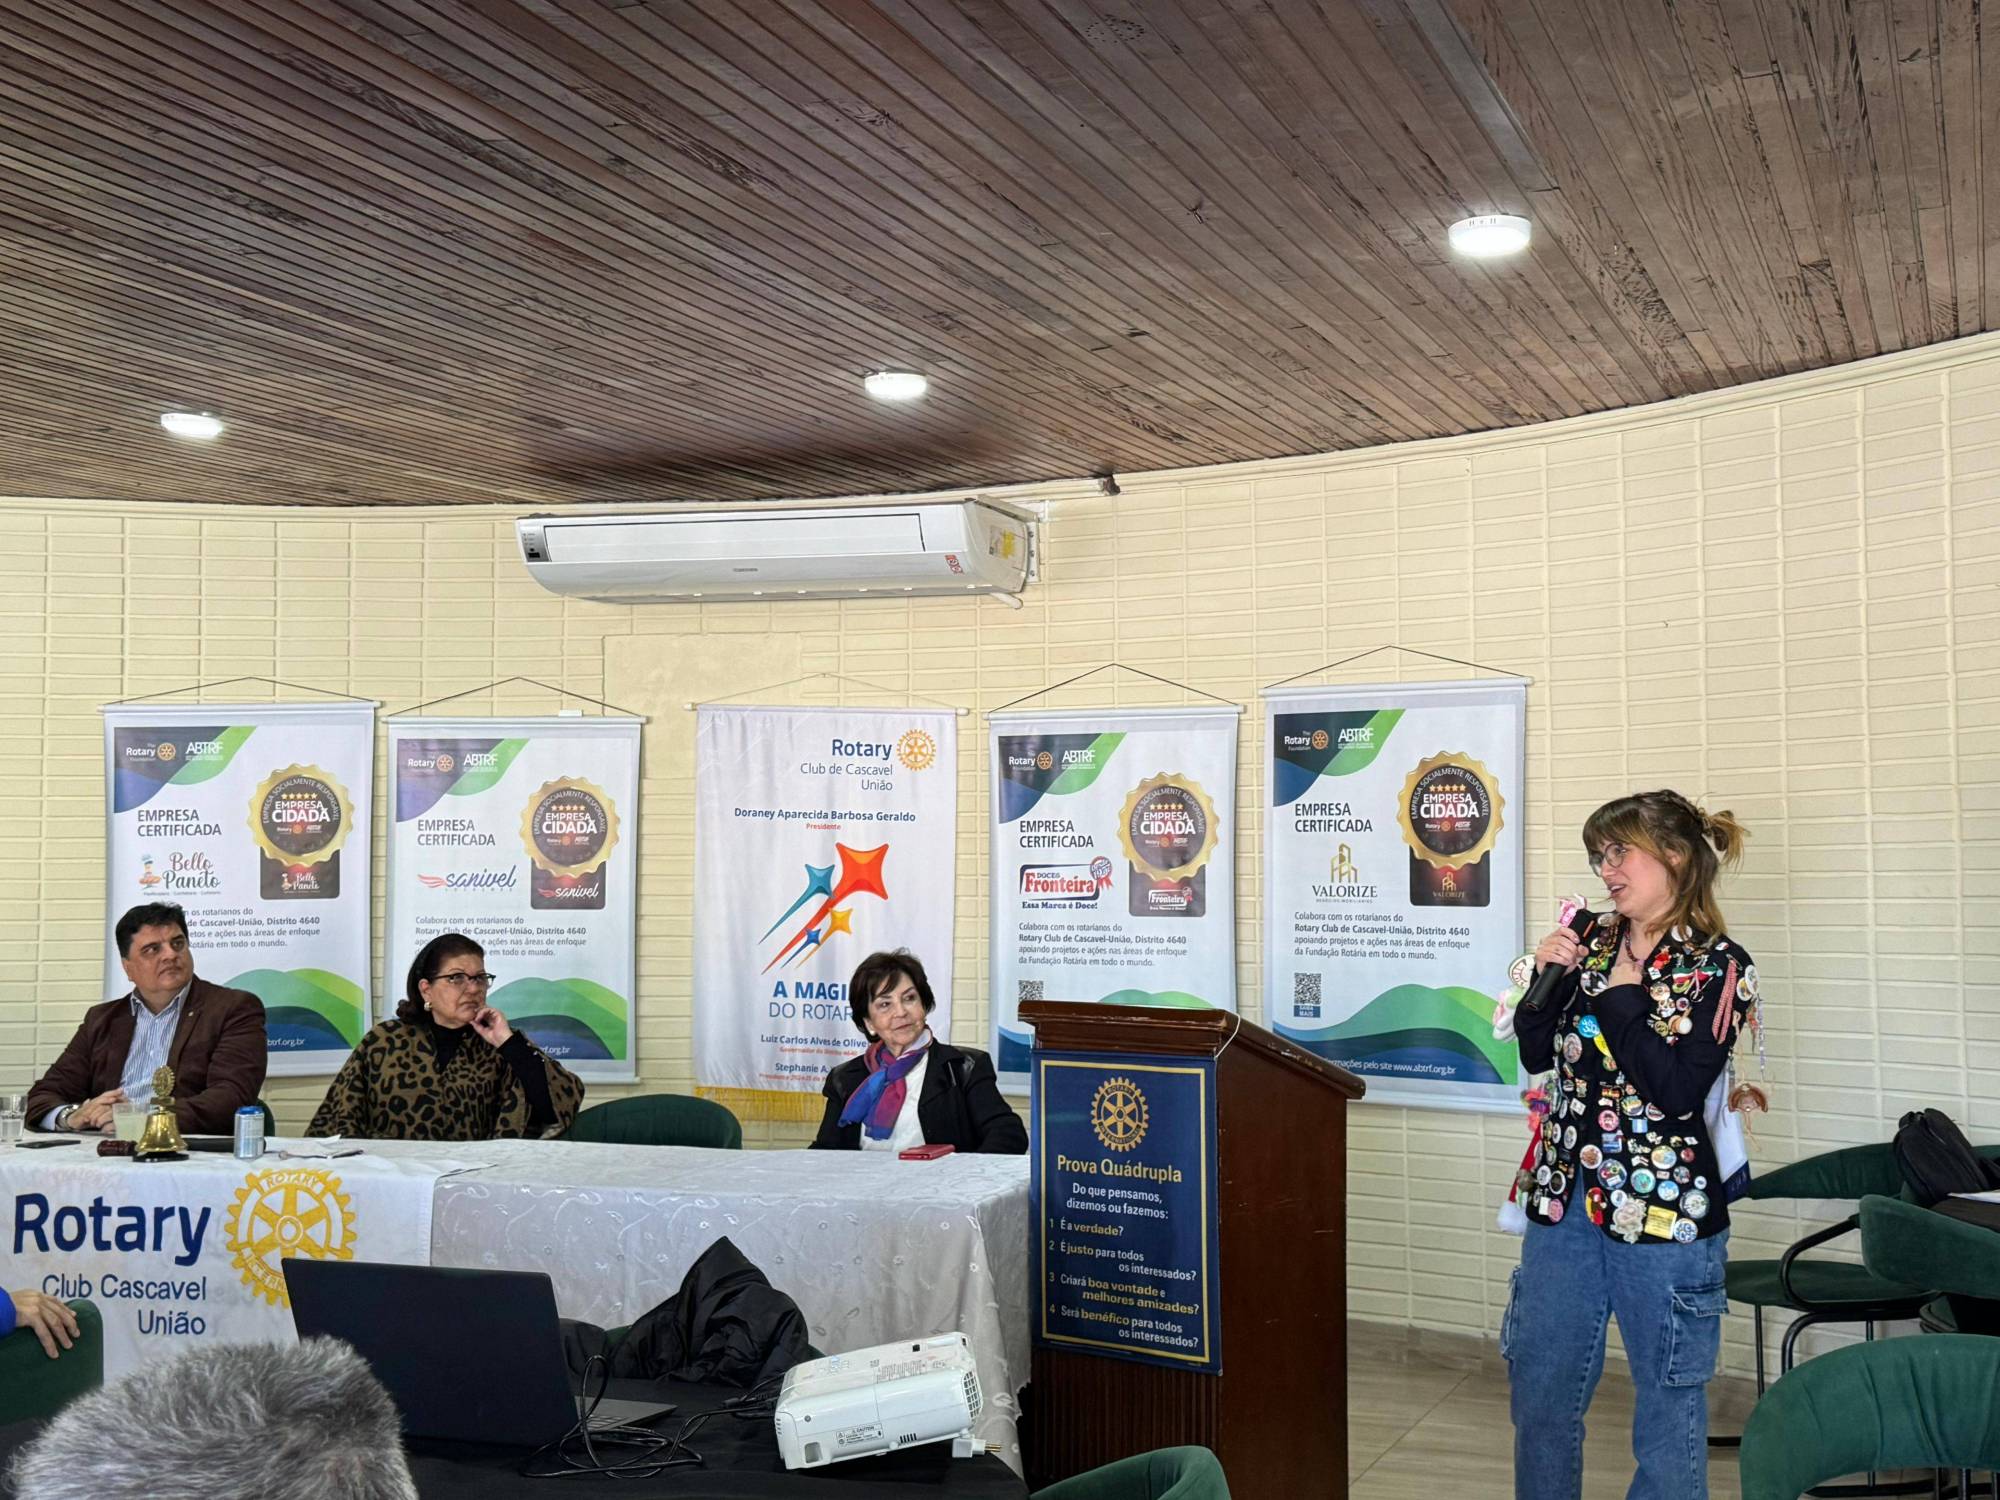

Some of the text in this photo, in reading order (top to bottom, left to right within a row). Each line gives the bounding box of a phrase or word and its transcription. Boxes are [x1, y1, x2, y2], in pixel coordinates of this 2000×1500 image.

[1284, 735, 1311, 746] Rotary
[1338, 727, 1374, 743] ABTRF
[126, 746, 156, 757] Rotary
[185, 741, 223, 754] ABTRF
[832, 738, 893, 761] Rotary
[463, 753, 498, 766] ABTRF
[1008, 756, 1036, 767] Rotary
[1062, 749, 1096, 763] ABTRF
[408, 758, 436, 769] Rotary
[800, 762, 893, 777] Club de Cascavel
[861, 778, 893, 791] União
[275, 800, 324, 810] EMPRESA
[1423, 793, 1472, 803] EMPRESA
[137, 808, 200, 822] EMPRESA
[734, 807, 916, 822] Doraney Aparecida Barbosa Geraldo
[1143, 811, 1189, 821] EMPRESA
[1294, 802, 1351, 816] EMPRESA
[545, 812, 591, 821] EMPRESA
[137, 823, 222, 837] CERTIFICADA
[417, 819, 475, 832] EMPRESA
[1020, 820, 1075, 833] EMPRESA
[1294, 818, 1373, 833] CERTIFICADA
[417, 833, 496, 846] CERTIFICADA
[1019, 834, 1094, 849] CERTIFICADA
[170, 851, 213, 872] Bello
[445, 865, 518, 889] sanivel
[1024, 872, 1096, 894] Fronteira
[555, 882, 600, 899] sanivel
[1312, 884, 1379, 899] VALORIZE
[1150, 893, 1186, 904] Fronteira
[202, 908, 241, 916] rotarianos
[243, 907, 253, 915] do
[1075, 902, 1099, 910] Doce!
[187, 916, 320, 928] de Cascavel-União, Distrito 4640
[1294, 912, 1326, 920] Colabora
[1354, 913, 1392, 922] rotarianos
[1393, 913, 1404, 922] do
[415, 927, 440, 936] Rotary
[462, 927, 472, 935] de
[473, 926, 535, 936] Cascavel-União,
[536, 927, 565, 935] Distrito
[566, 927, 586, 935] 4640
[1018, 922, 1049, 931] Colabora
[1076, 923, 1111, 932] rotarianos
[1112, 923, 1122, 932] do
[1294, 924, 1470, 936] Rotary Club de Cascavel-União, Distrito 4640
[1018, 934, 1187, 944] Rotary Club de Cascavel-União, Distrito 4640
[1294, 936, 1328, 945] apoiando
[1329, 937, 1359, 946] projetos
[1366, 937, 1388, 947] ações
[1389, 939, 1403, 947] nas
[1404, 938, 1424, 947] áreas
[1426, 939, 1436, 948] de
[1438, 939, 1471, 950] enfoque
[1305, 948, 1340, 958] Fundação
[1341, 949, 1367, 957] Rotária
[1382, 950, 1399, 958] todo
[1408, 951, 1437, 960] mundo.
[773, 981, 847, 1000] A MAGI
[769, 1001, 853, 1020] DO ROTAR
[760, 1034, 867, 1048] Luiz Carlos Alves de Olive
[775, 1063, 819, 1073] Stephanie
[1363, 1060, 1457, 1076] pelo site www.abtrf.org.br
[1057, 1154, 1182, 1184] Prova Quádrupla
[266, 1172, 318, 1192] ROTARY
[1072, 1182, 1163, 1204] Do que pensamos,
[1066, 1197, 1169, 1220] dizemos ou fazemos:
[13, 1193, 211, 1266] Rotary
[1049, 1216, 1124, 1236] 1 É a verdade?
[1049, 1240, 1145, 1262] 2 É justo para todos
[1118, 1262, 1197, 1281] os interessados?
[42, 1273, 207, 1300] Club Cascavel
[1049, 1272, 1166, 1298] 3 Criará boa vontade e
[1082, 1289, 1199, 1315] melhores amizades?
[138, 1309, 206, 1335] União
[1049, 1304, 1183, 1333] 4 Será benéfico para todos
[1118, 1327, 1199, 1348] os interessados?
